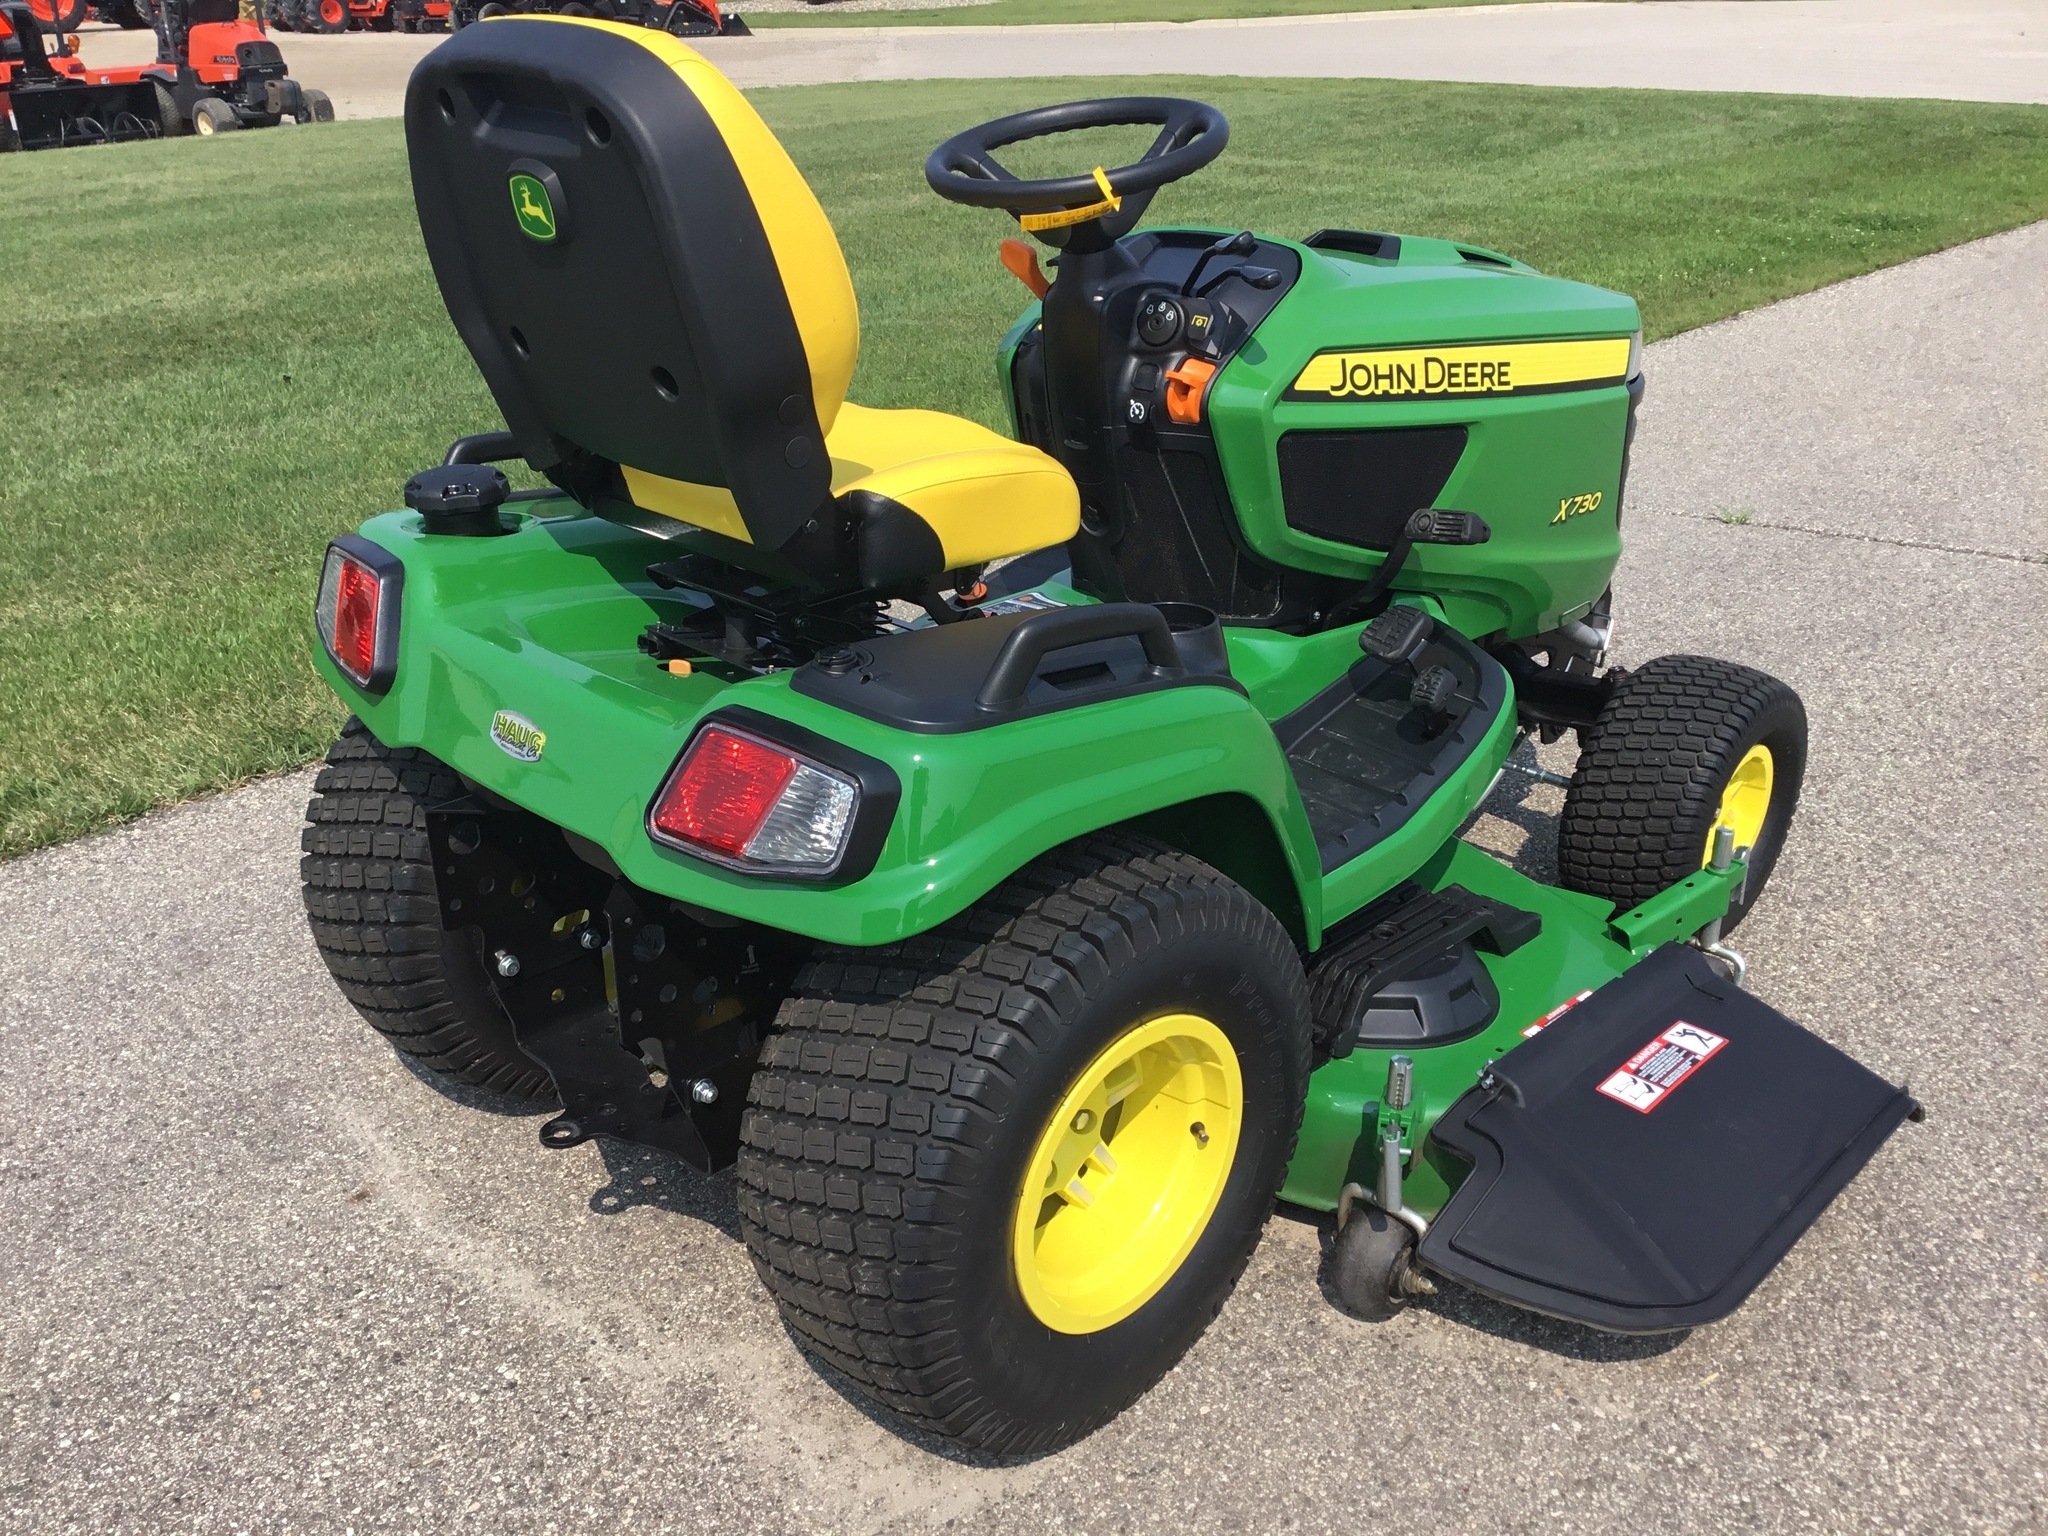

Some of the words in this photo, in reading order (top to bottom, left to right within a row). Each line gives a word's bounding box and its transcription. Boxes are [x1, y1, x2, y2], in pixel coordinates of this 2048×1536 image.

[1330, 358, 1416, 392] JOHN
[1424, 356, 1512, 389] DEERE
[1550, 491, 1602, 526] X730
[495, 712, 547, 754] HAUG
[1633, 1041, 1663, 1066] DANGER
